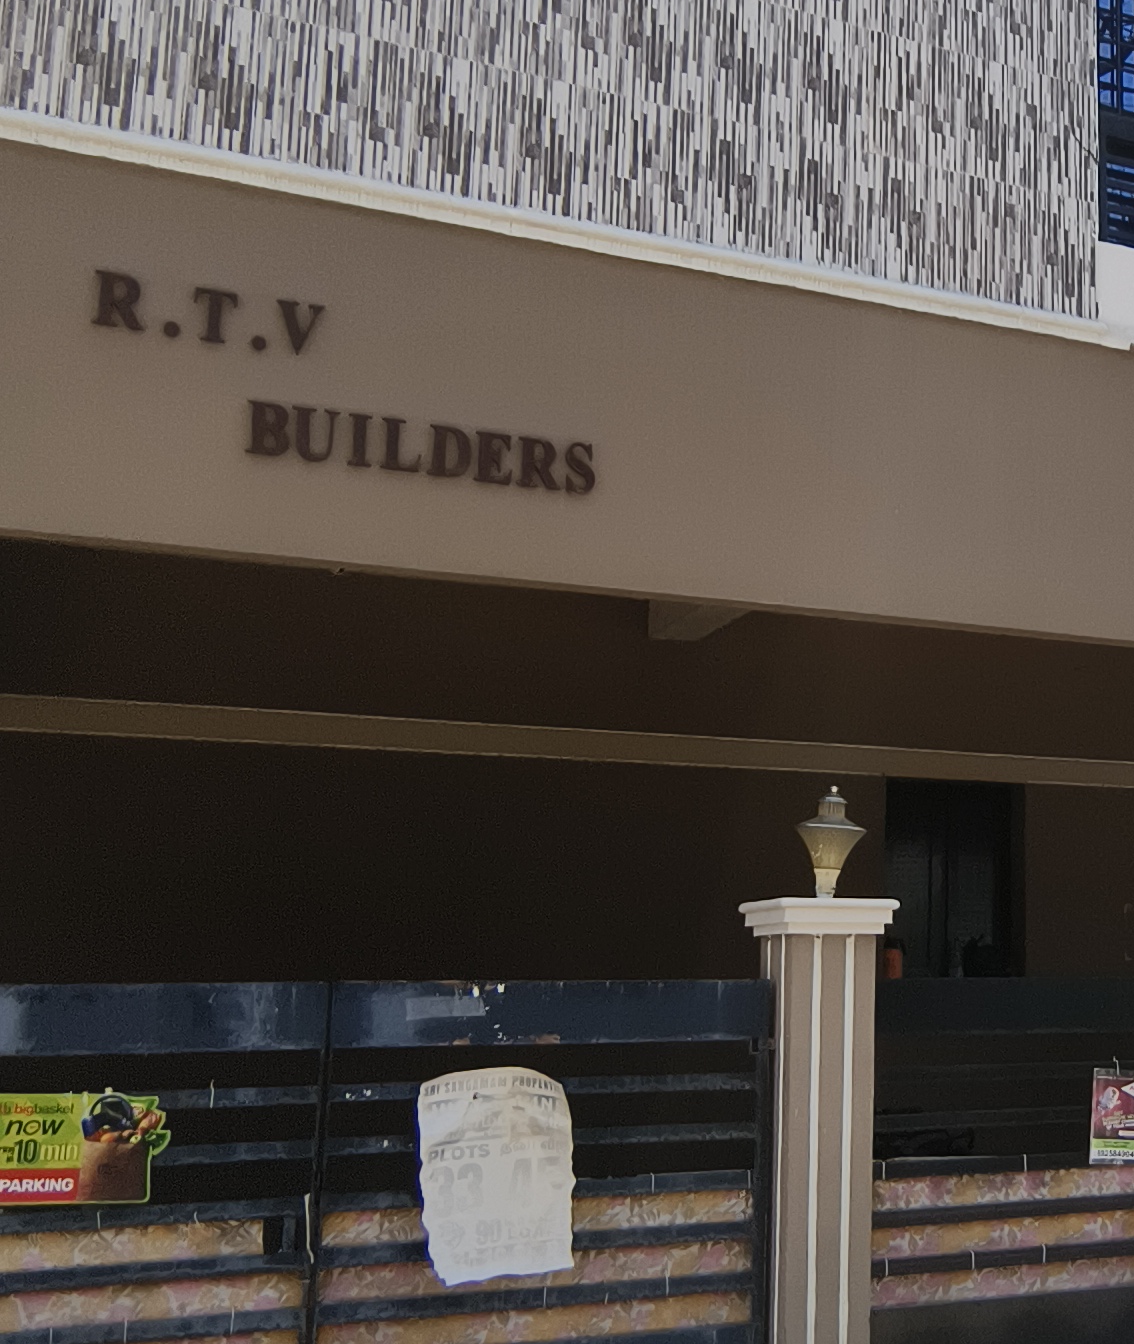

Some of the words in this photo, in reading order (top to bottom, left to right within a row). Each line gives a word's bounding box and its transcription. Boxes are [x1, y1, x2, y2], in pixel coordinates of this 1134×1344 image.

[90, 268, 326, 356] R.T.V
[244, 398, 597, 495] BUILDERS
[4, 1118, 66, 1136] now
[13, 1138, 39, 1164] 10
[427, 1143, 491, 1164] PLOTS
[0, 1177, 75, 1193] PARKING
